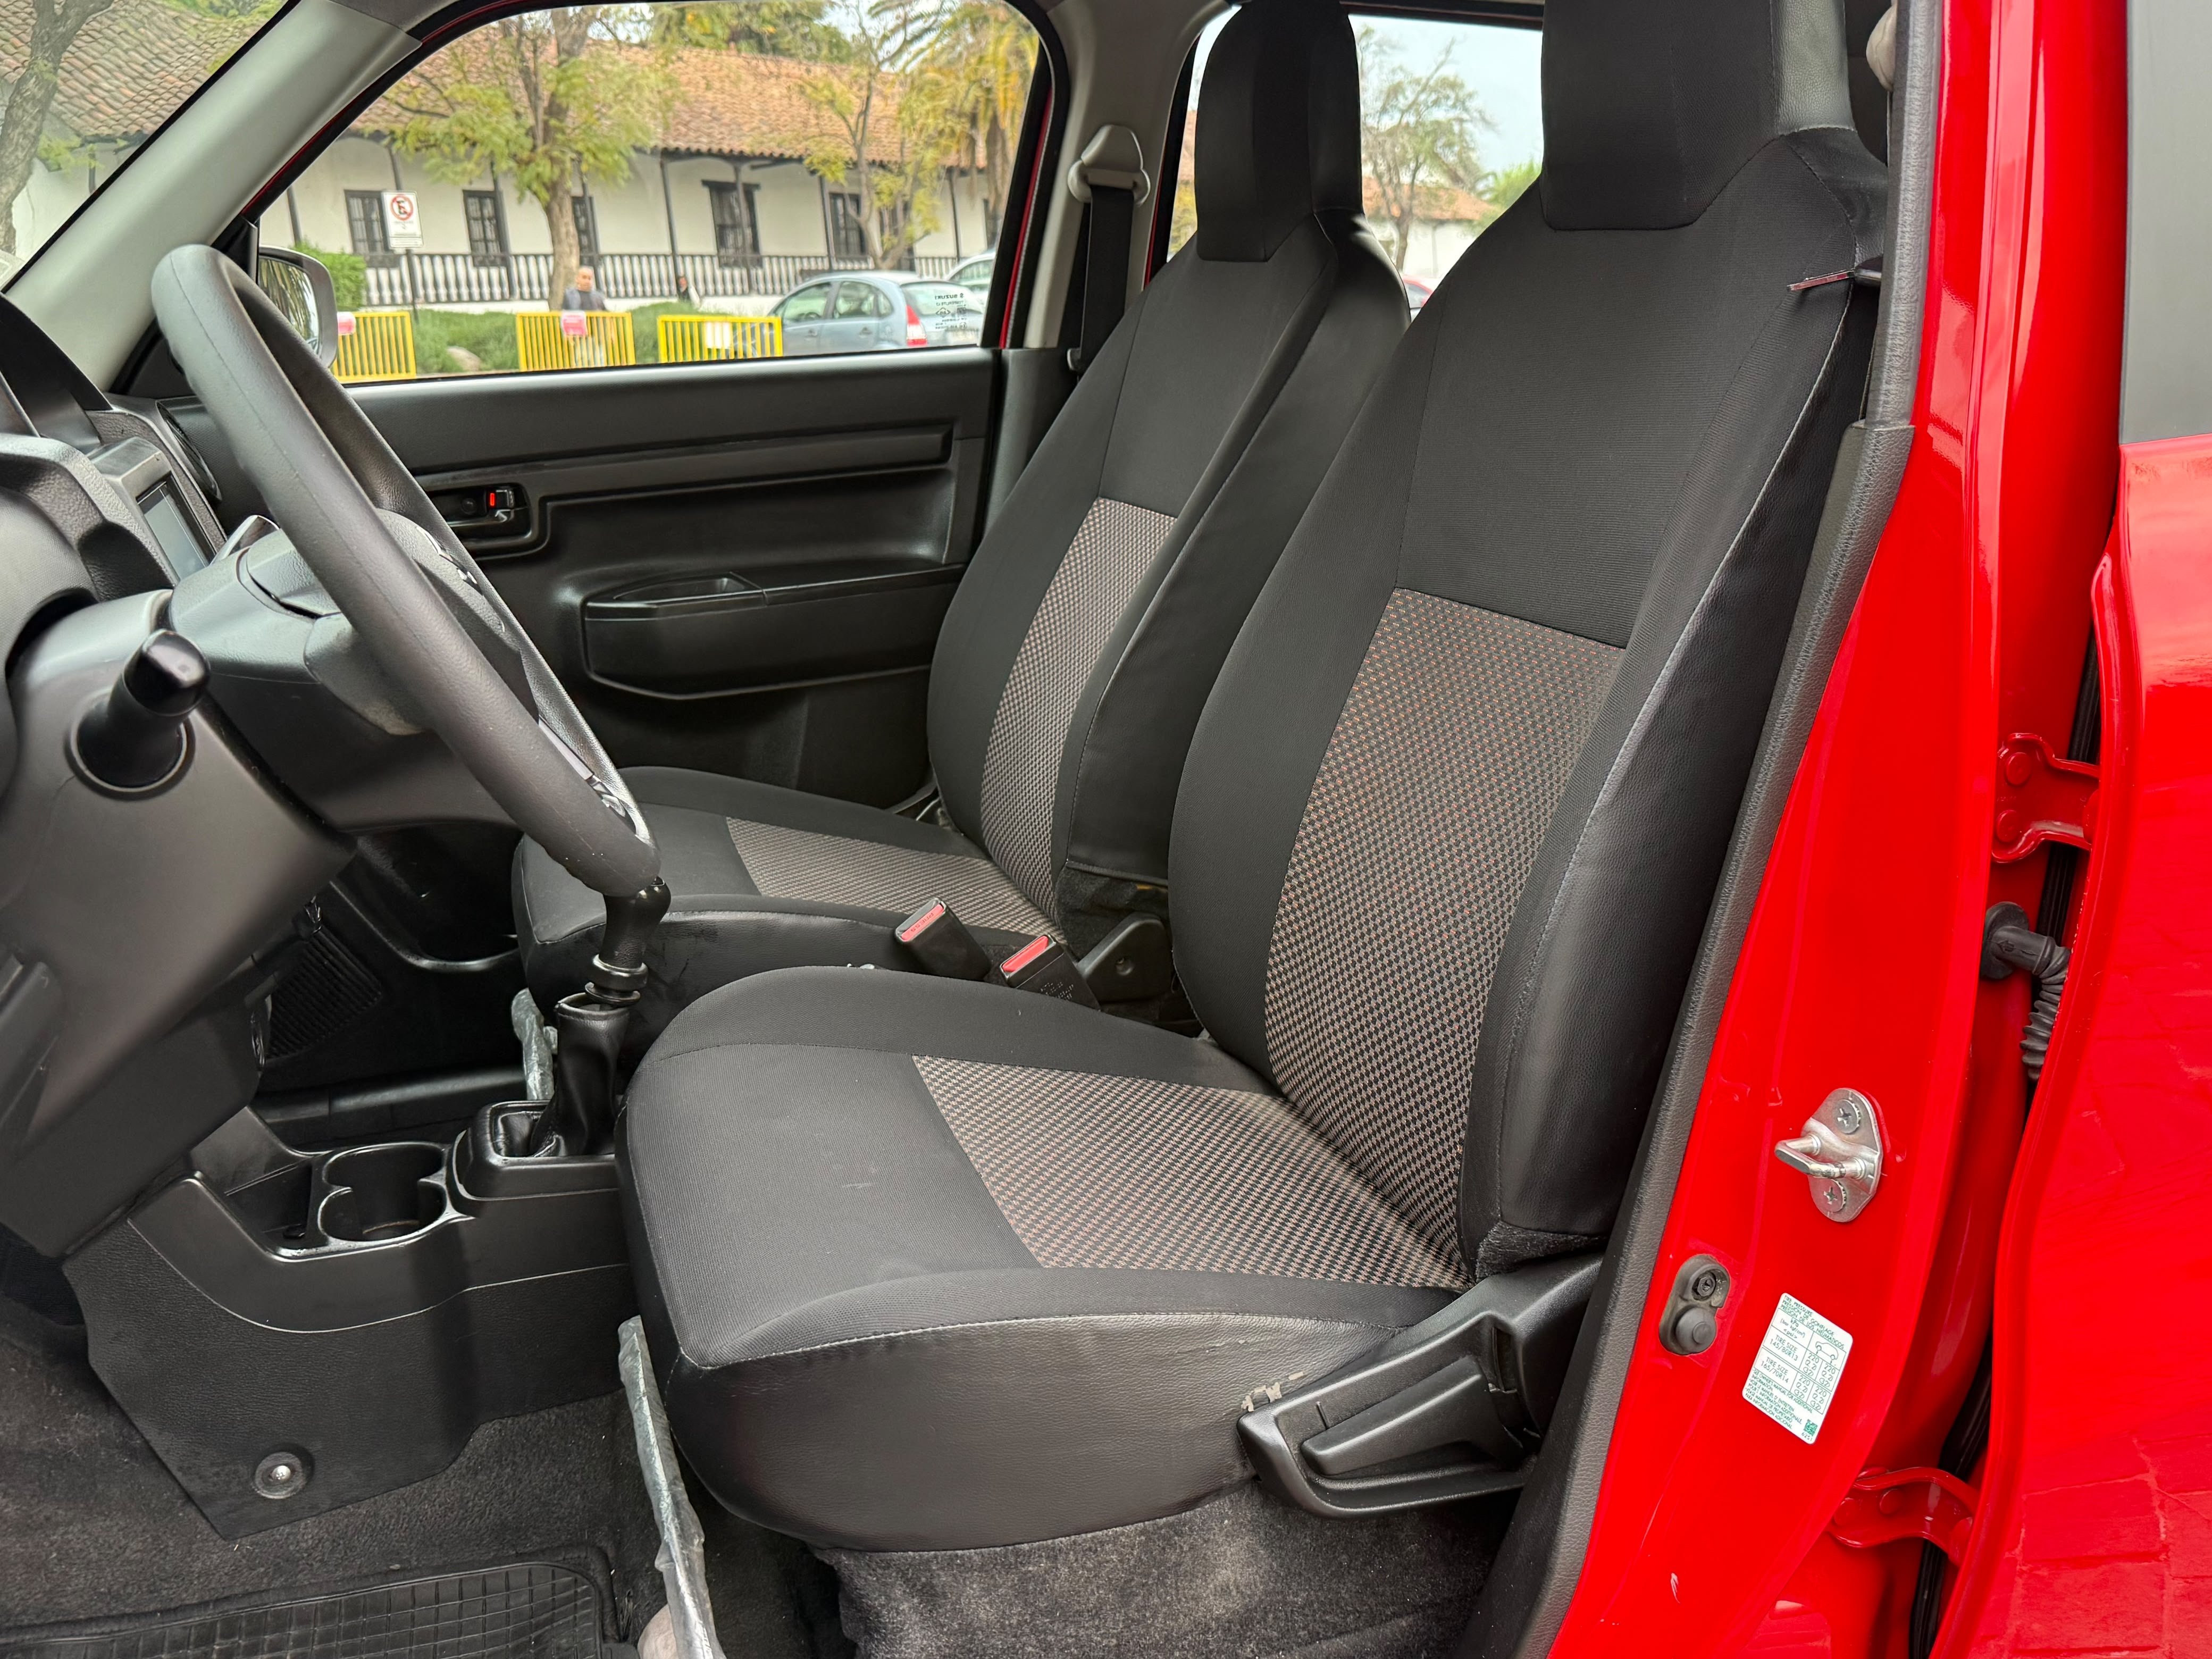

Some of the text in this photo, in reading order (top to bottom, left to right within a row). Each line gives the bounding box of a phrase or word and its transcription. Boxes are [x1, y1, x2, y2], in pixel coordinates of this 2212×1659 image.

[911, 912, 934, 932] PRESS
[1793, 1301, 1813, 1317] PRESSURE
[1790, 1318, 1799, 1327] kPa
[1769, 1338, 1798, 1361] 145/80R13
[1774, 1334, 1797, 1353] TIRE SIZE
[1807, 1352, 1820, 1363] 220
[1760, 1360, 1789, 1383] 165/70R14
[1765, 1356, 1788, 1375] TIRE SIZE
[1802, 1365, 1814, 1377] (32)
[1824, 1363, 1836, 1375] 220
[1798, 1375, 1811, 1386] 220
[1819, 1376, 1831, 1388] (32)
[1793, 1388, 1805, 1400] (32)
[1815, 1386, 1827, 1397] 220
[1809, 1399, 1822, 1411] (32)
